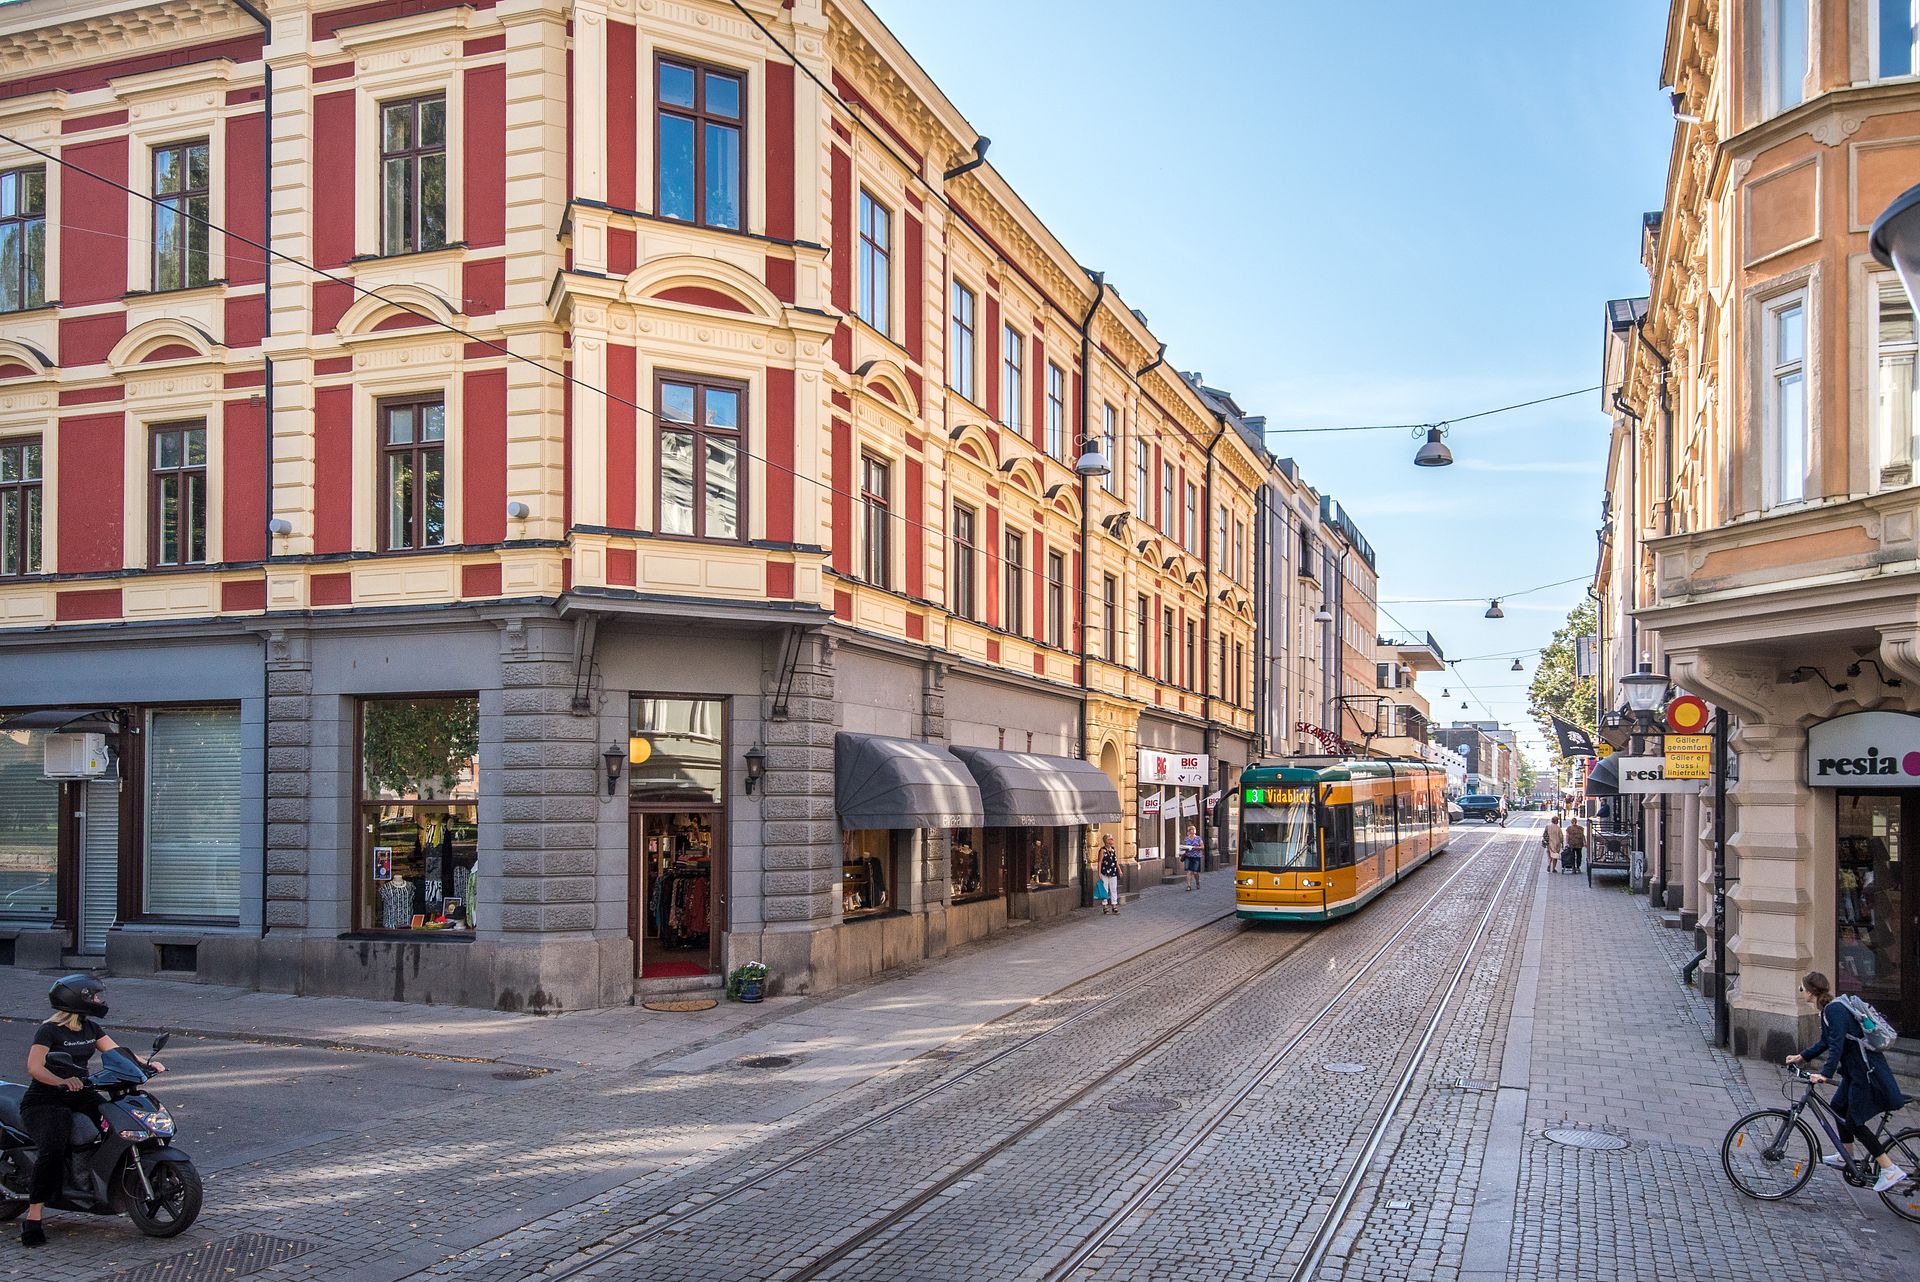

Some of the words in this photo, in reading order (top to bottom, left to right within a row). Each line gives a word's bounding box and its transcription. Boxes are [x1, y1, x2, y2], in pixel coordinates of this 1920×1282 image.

[1676, 736, 1699, 744] Gäller
[1667, 744, 1708, 752] genomfart
[1181, 757, 1198, 767] BIG
[1816, 746, 1900, 776] resia
[1625, 765, 1664, 780] resi
[1667, 769, 1706, 777] linjetrafik
[1251, 789, 1259, 803] 3
[1267, 789, 1310, 803] Vidablick
